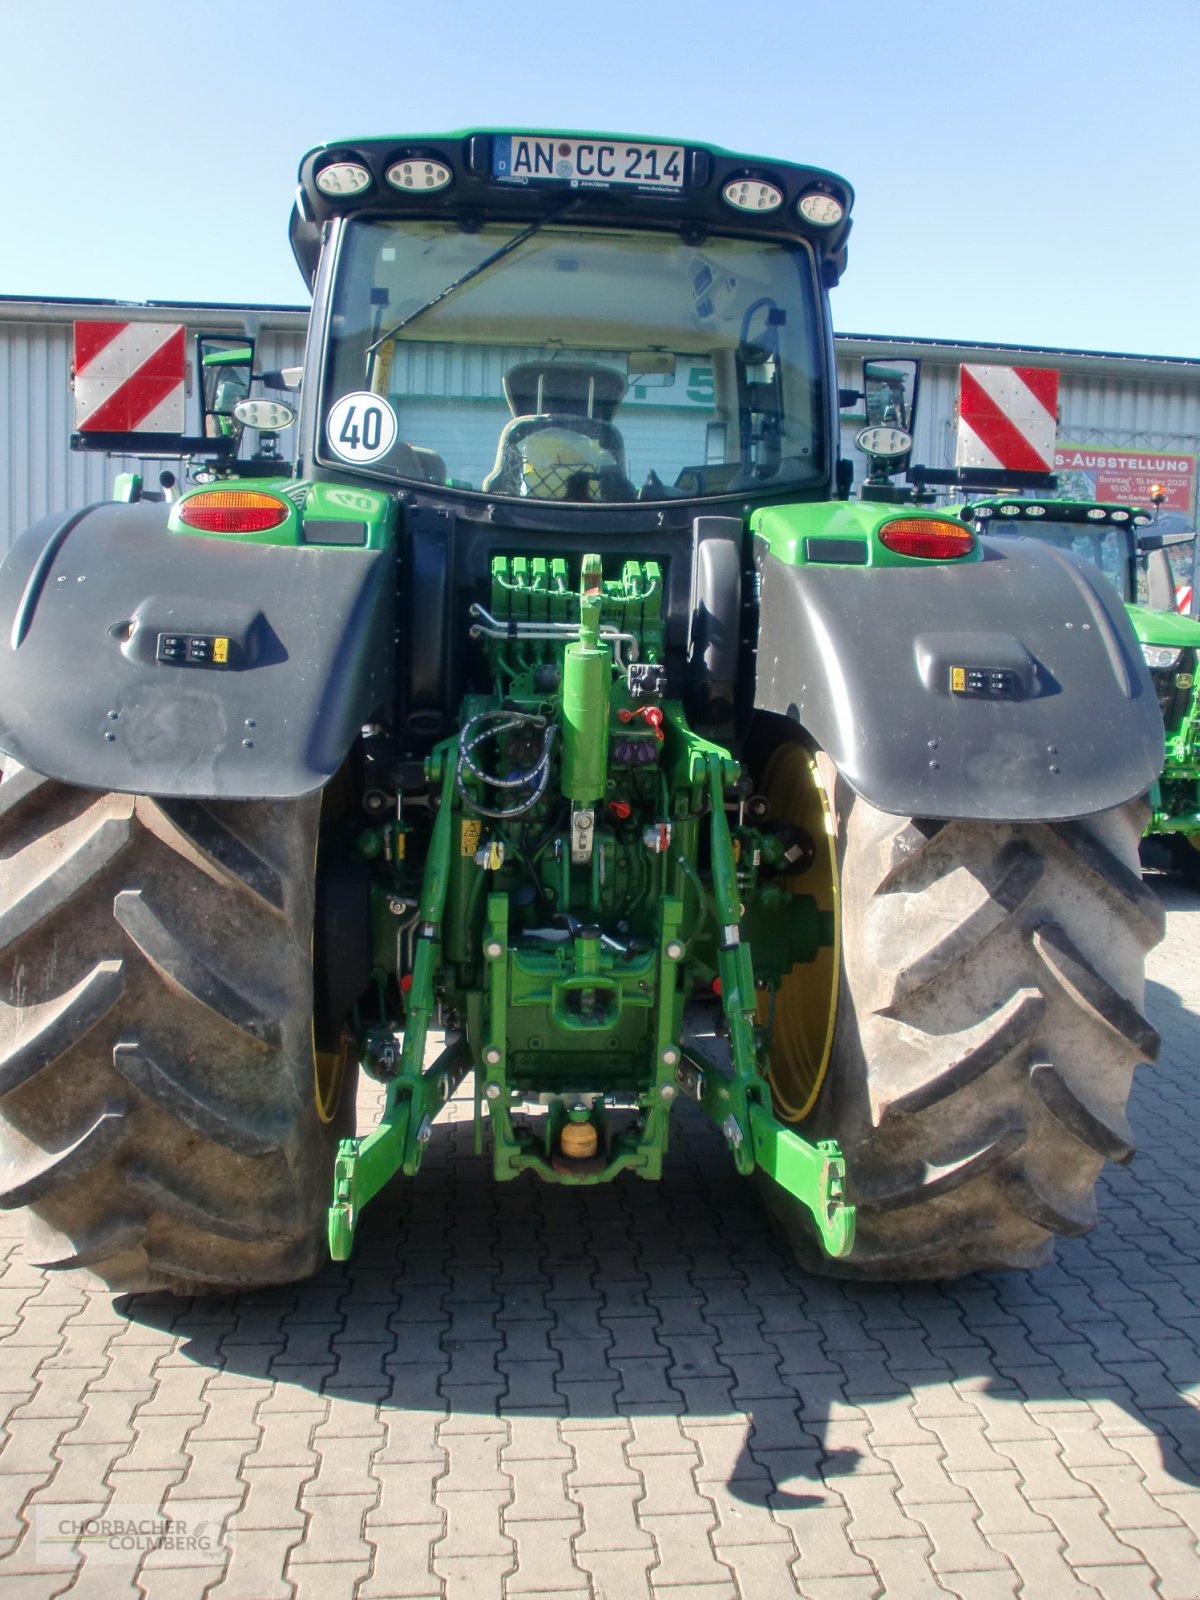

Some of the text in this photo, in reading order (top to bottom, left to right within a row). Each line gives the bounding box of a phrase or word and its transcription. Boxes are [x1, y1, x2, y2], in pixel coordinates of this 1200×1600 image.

[499, 160, 506, 170] D
[513, 141, 681, 182] AN CC 214
[339, 405, 382, 451] 40
[1167, 478, 1188, 487] 2026
